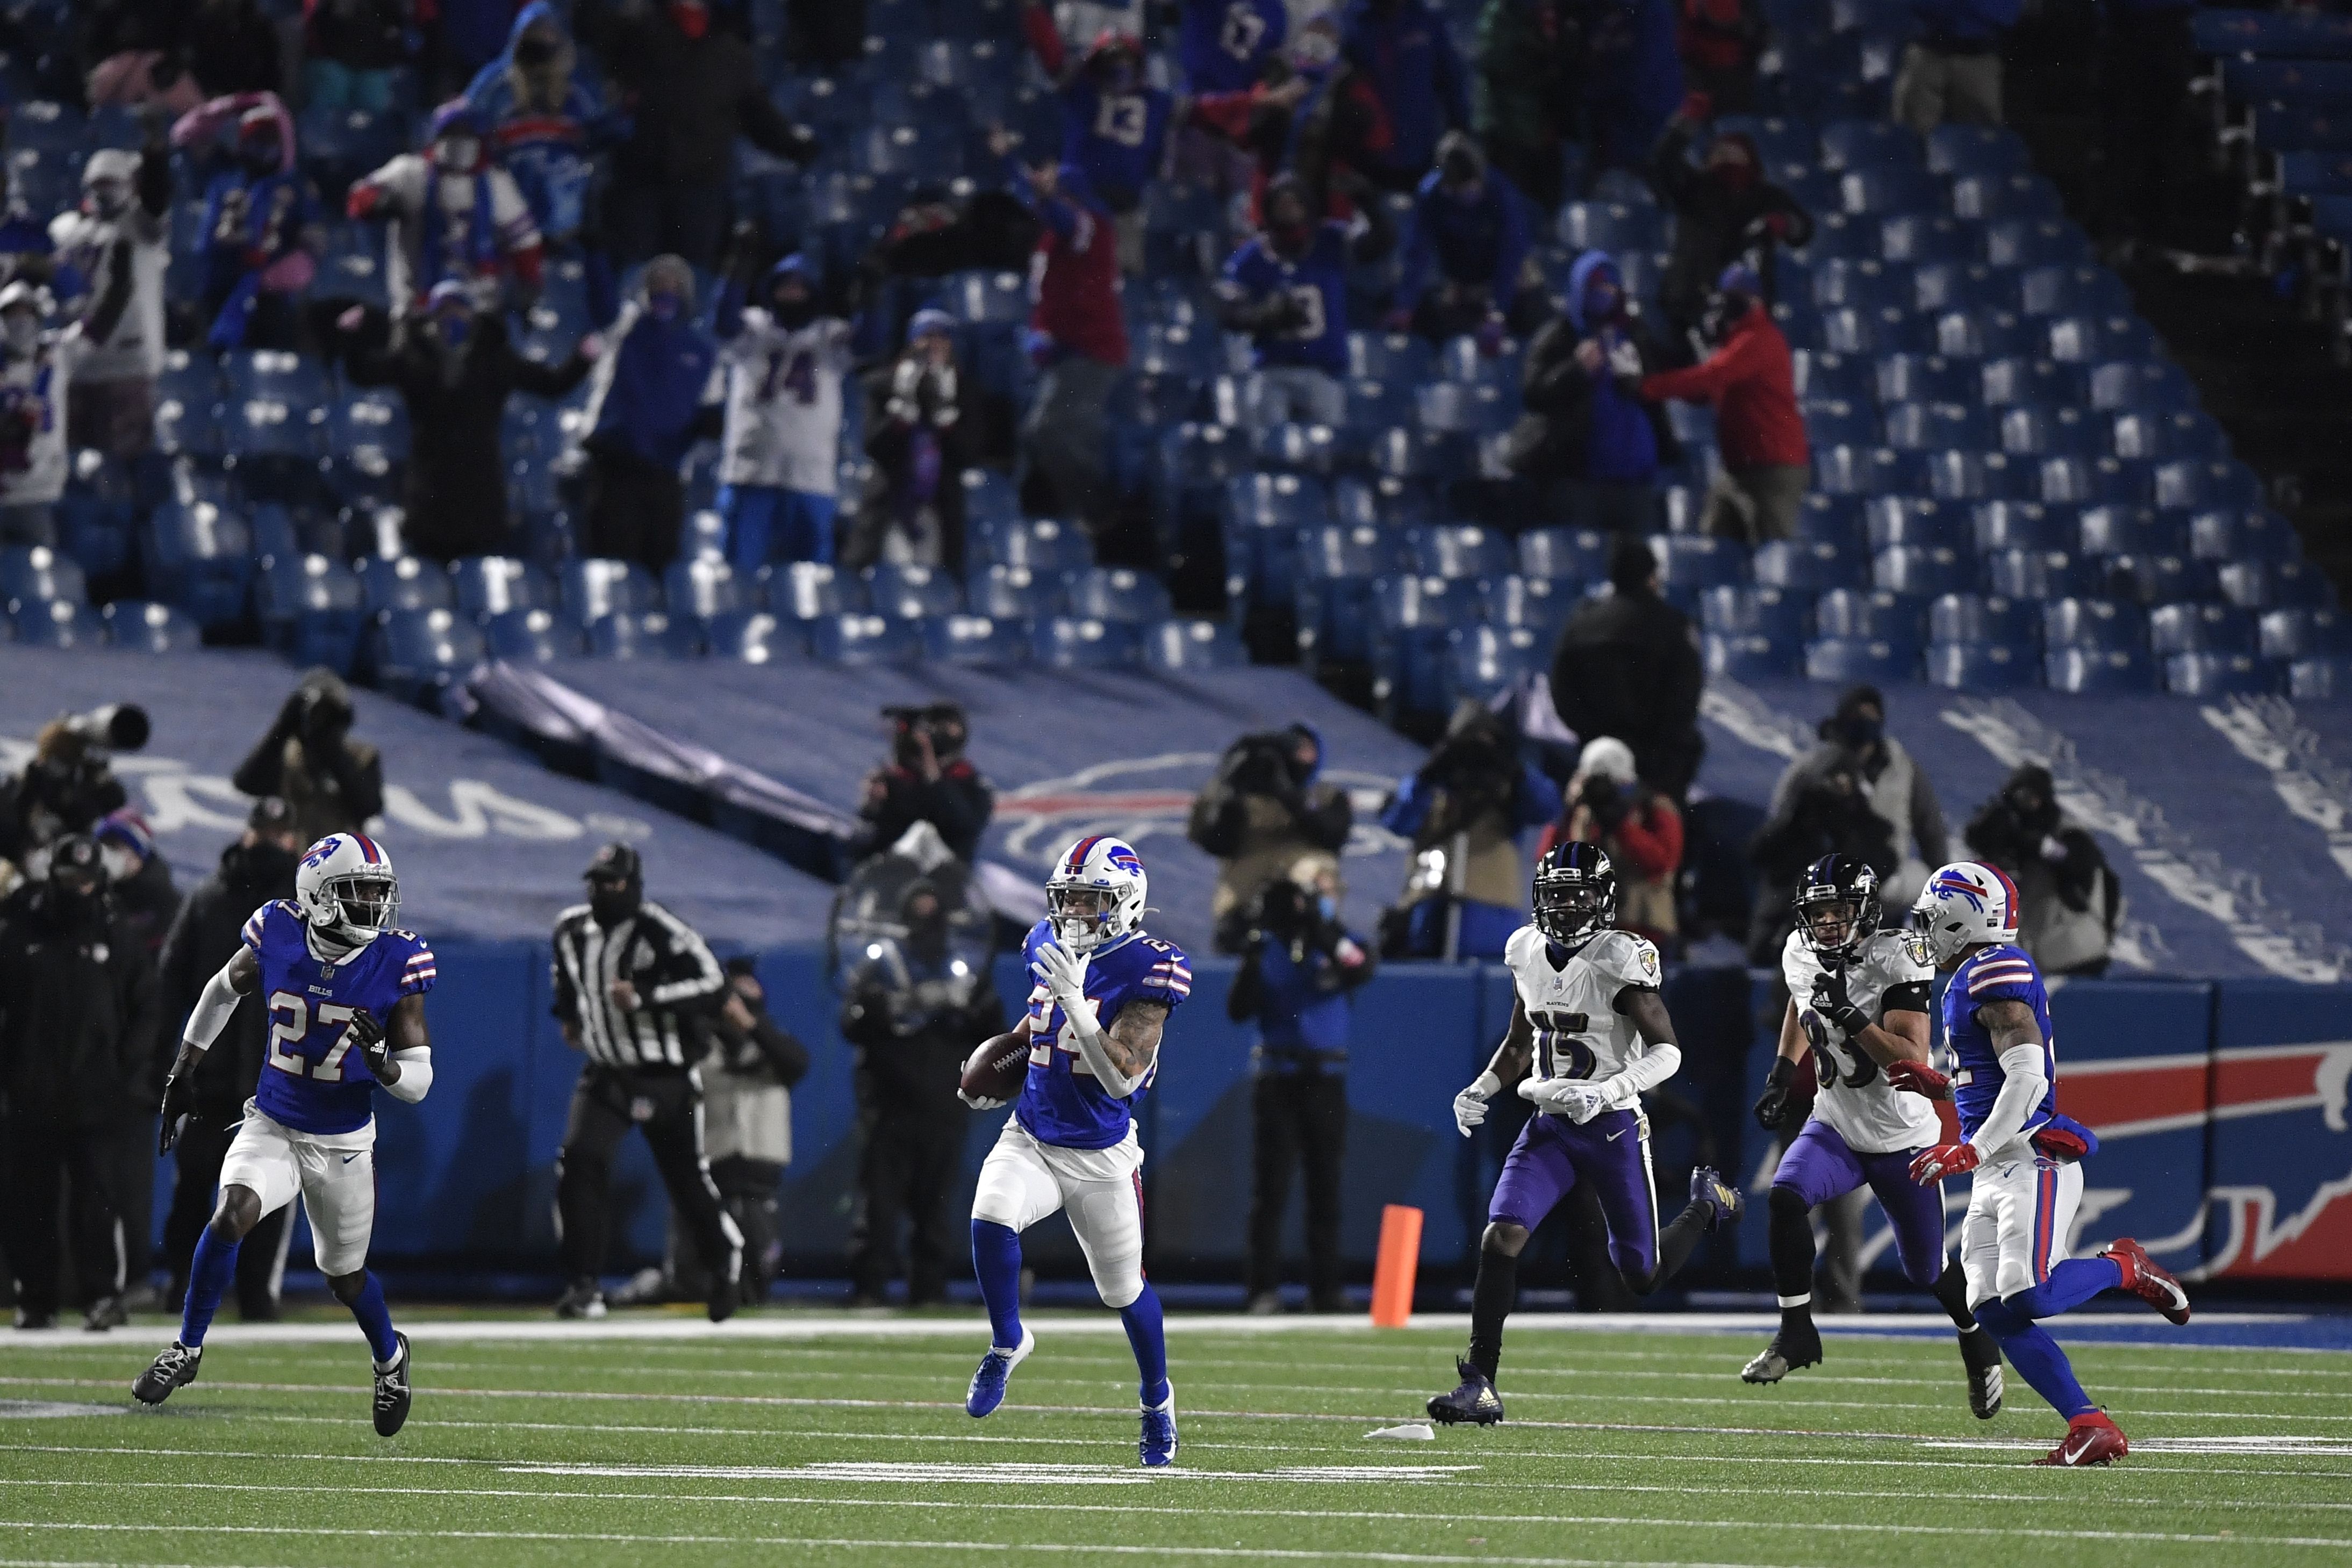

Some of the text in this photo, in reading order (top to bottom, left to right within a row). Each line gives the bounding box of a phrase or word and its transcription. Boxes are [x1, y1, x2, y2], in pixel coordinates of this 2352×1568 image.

[308, 984, 333, 997] BILLS
[269, 989, 370, 1083] 27
[1529, 1010, 1597, 1083] 15
